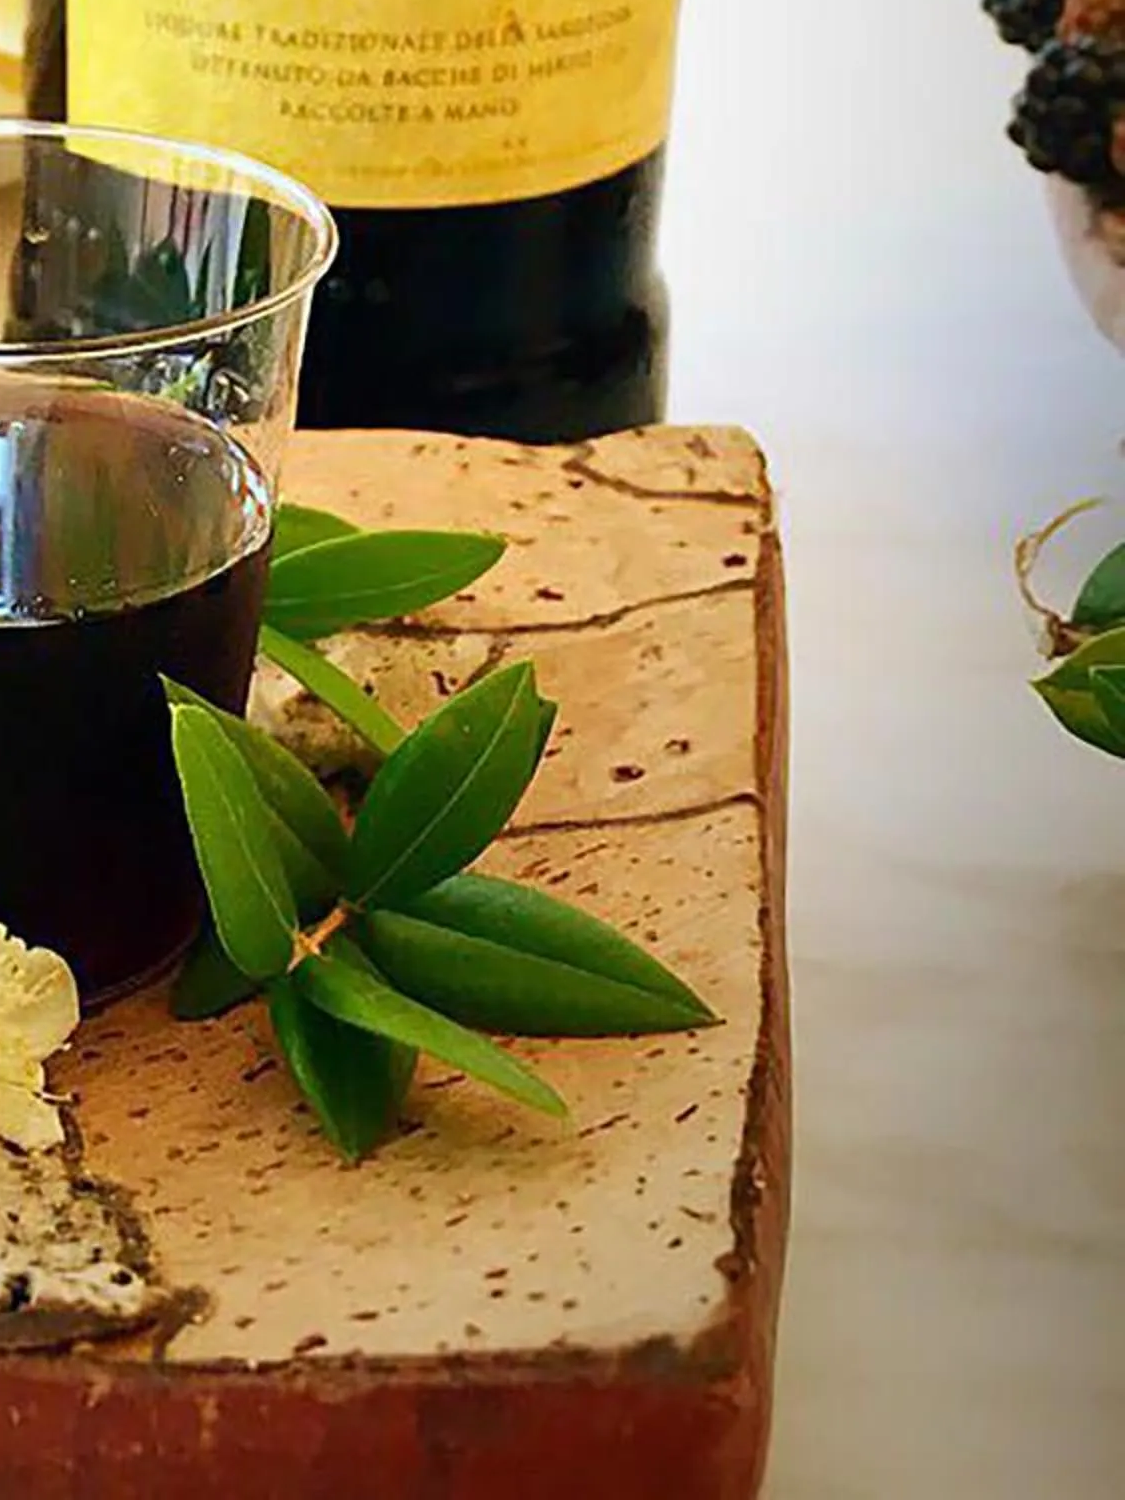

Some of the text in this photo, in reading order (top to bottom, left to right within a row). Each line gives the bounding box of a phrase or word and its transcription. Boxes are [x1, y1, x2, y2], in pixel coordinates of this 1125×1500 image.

[383, 66, 481, 88] BACCHE
[492, 63, 518, 84] DI
[415, 103, 436, 123] A
[444, 99, 519, 122] MANO
